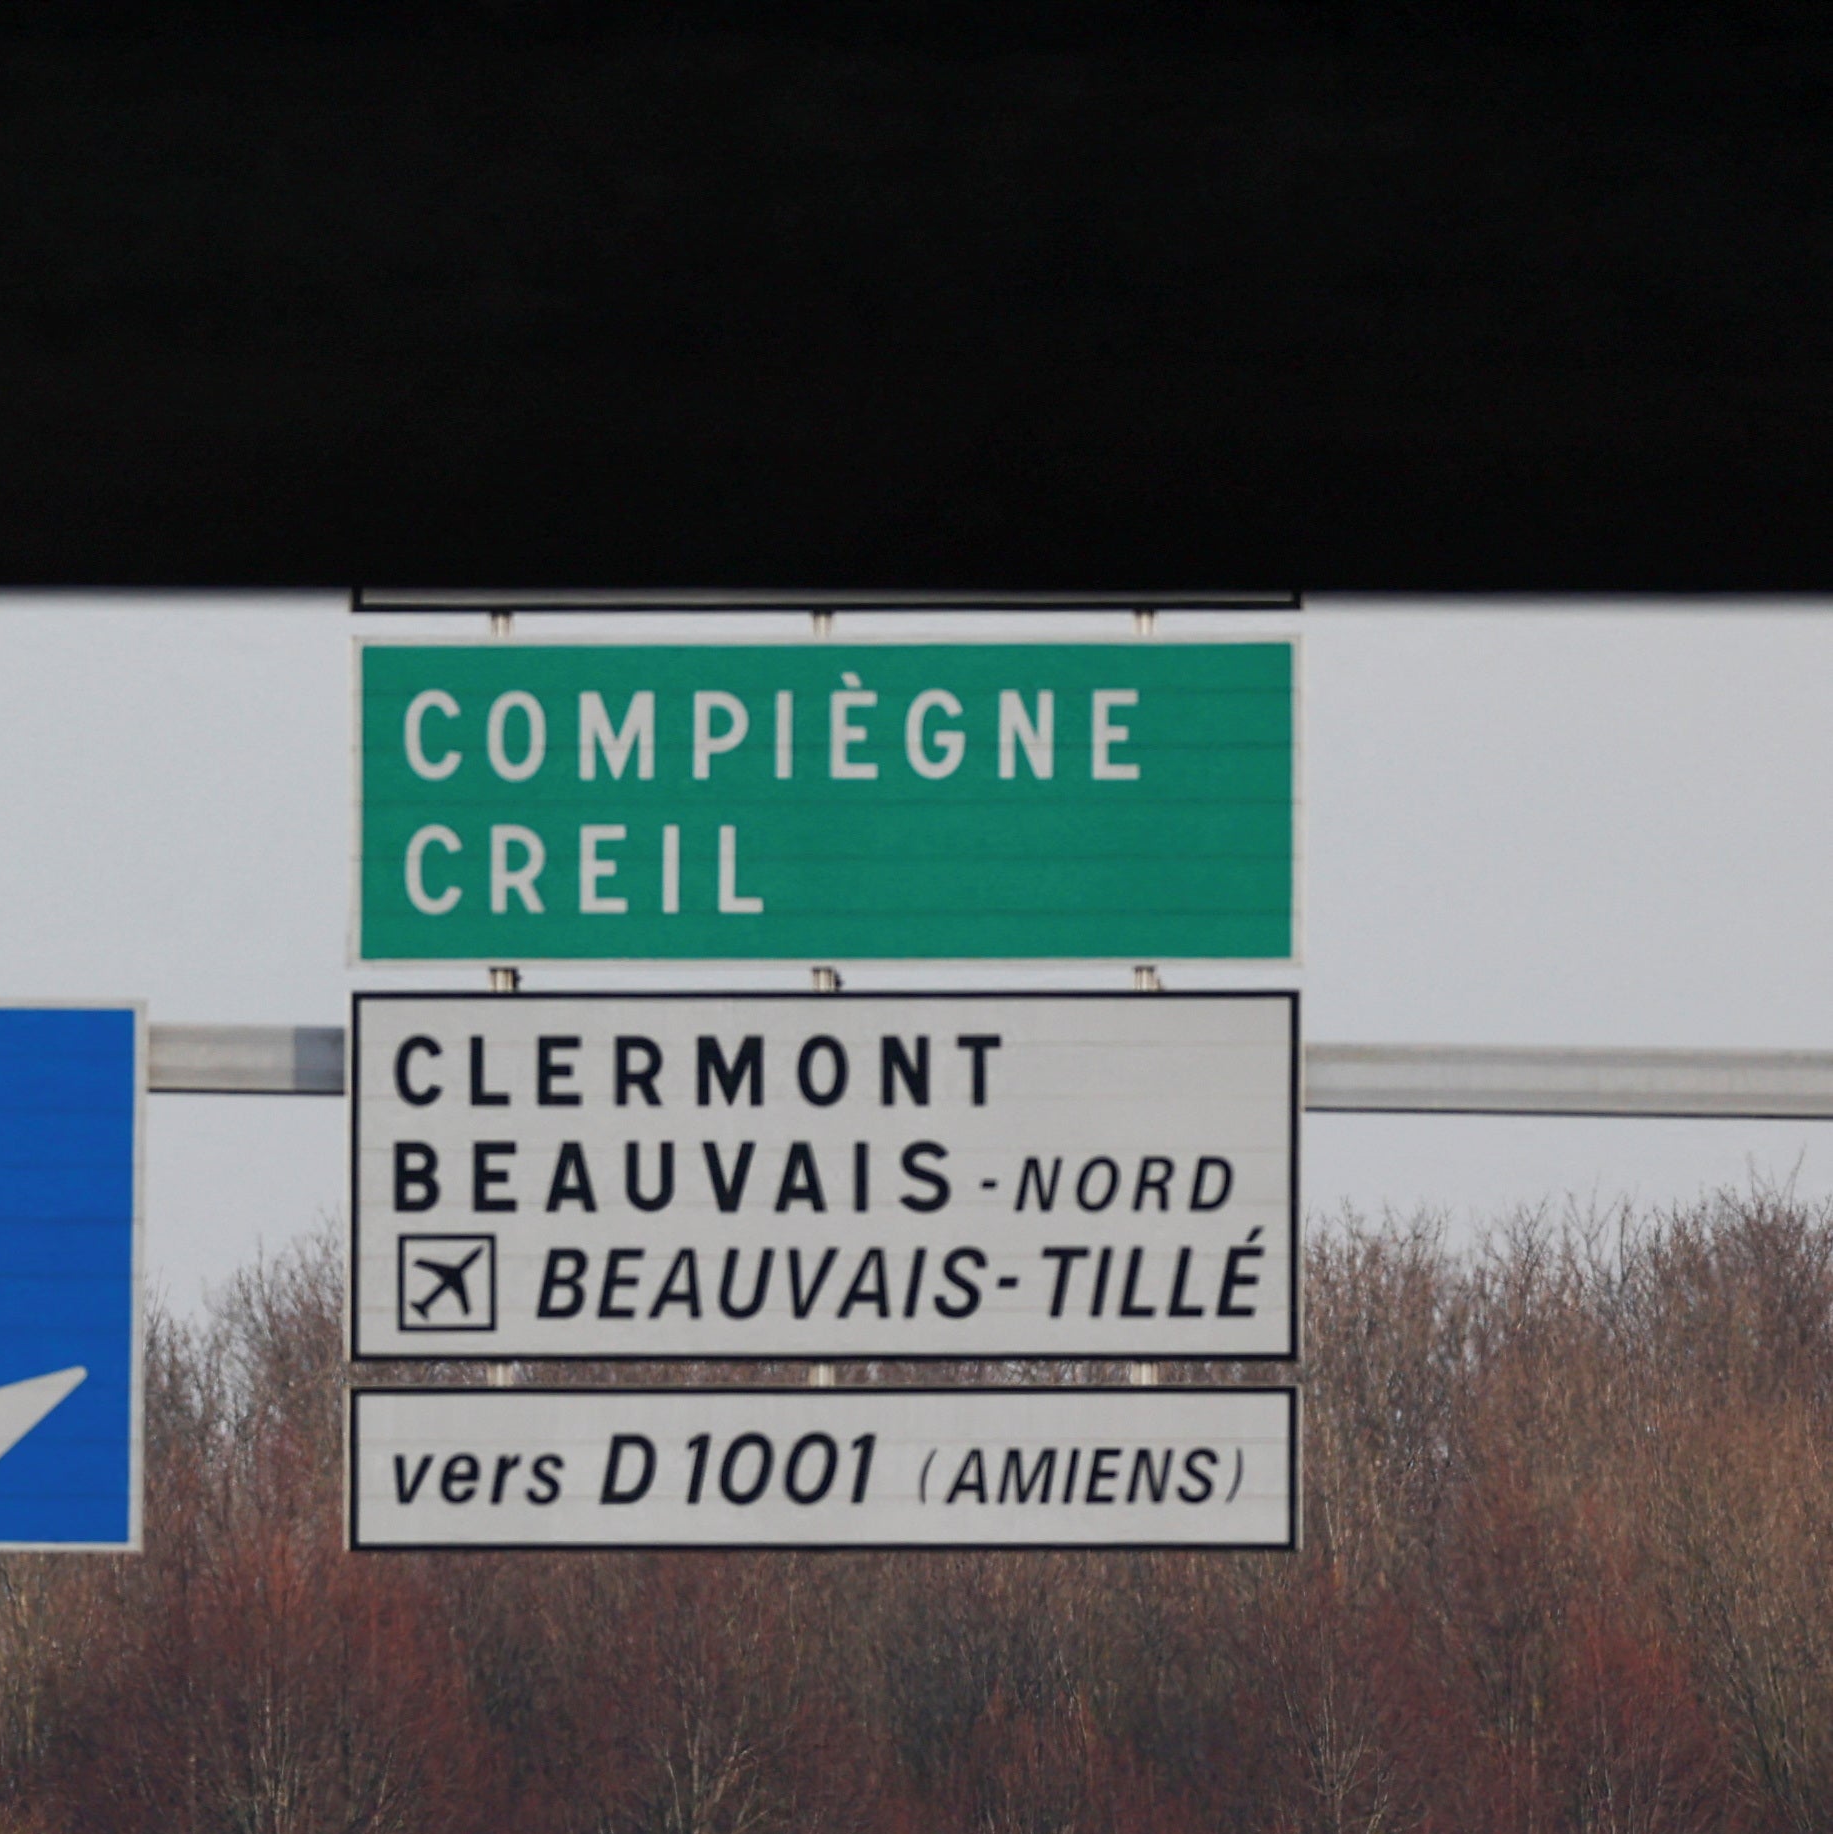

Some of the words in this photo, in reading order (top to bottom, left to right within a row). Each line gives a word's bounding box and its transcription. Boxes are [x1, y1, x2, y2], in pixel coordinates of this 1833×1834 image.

[403, 672, 1141, 781] COMPIÈGNE
[404, 824, 765, 915] CREIL
[393, 1034, 1002, 1107] CLERMONT
[394, 1452, 565, 1506] vers
[918, 1446, 1245, 1507] (AMIENS)
